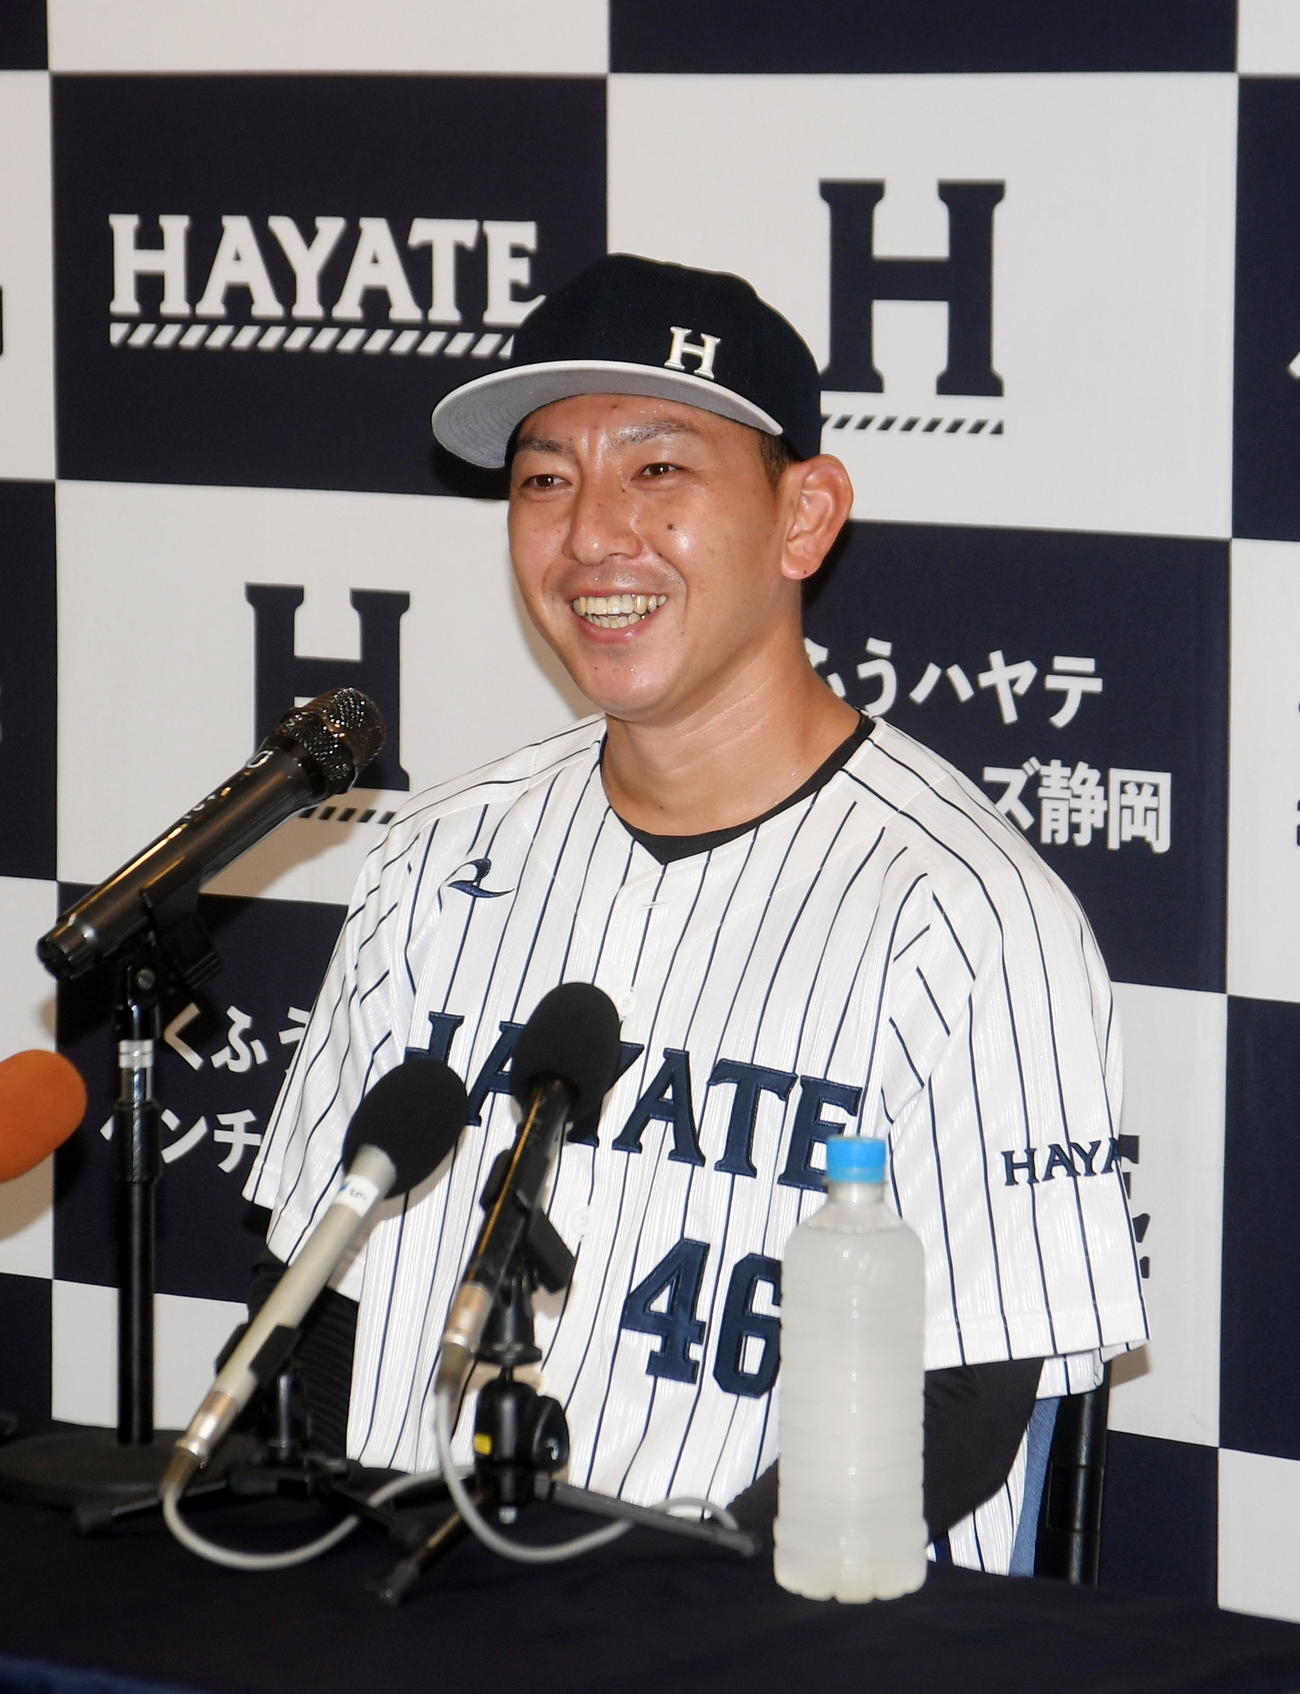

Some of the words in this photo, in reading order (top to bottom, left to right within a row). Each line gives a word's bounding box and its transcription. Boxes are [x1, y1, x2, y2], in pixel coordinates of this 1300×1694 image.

[108, 213, 546, 325] HAYATE
[818, 178, 1006, 397] H
[664, 326, 722, 380] H
[983, 756, 1172, 854] ズ静岡
[100, 1108, 262, 1174] ンチ
[621, 1237, 783, 1400] 46
